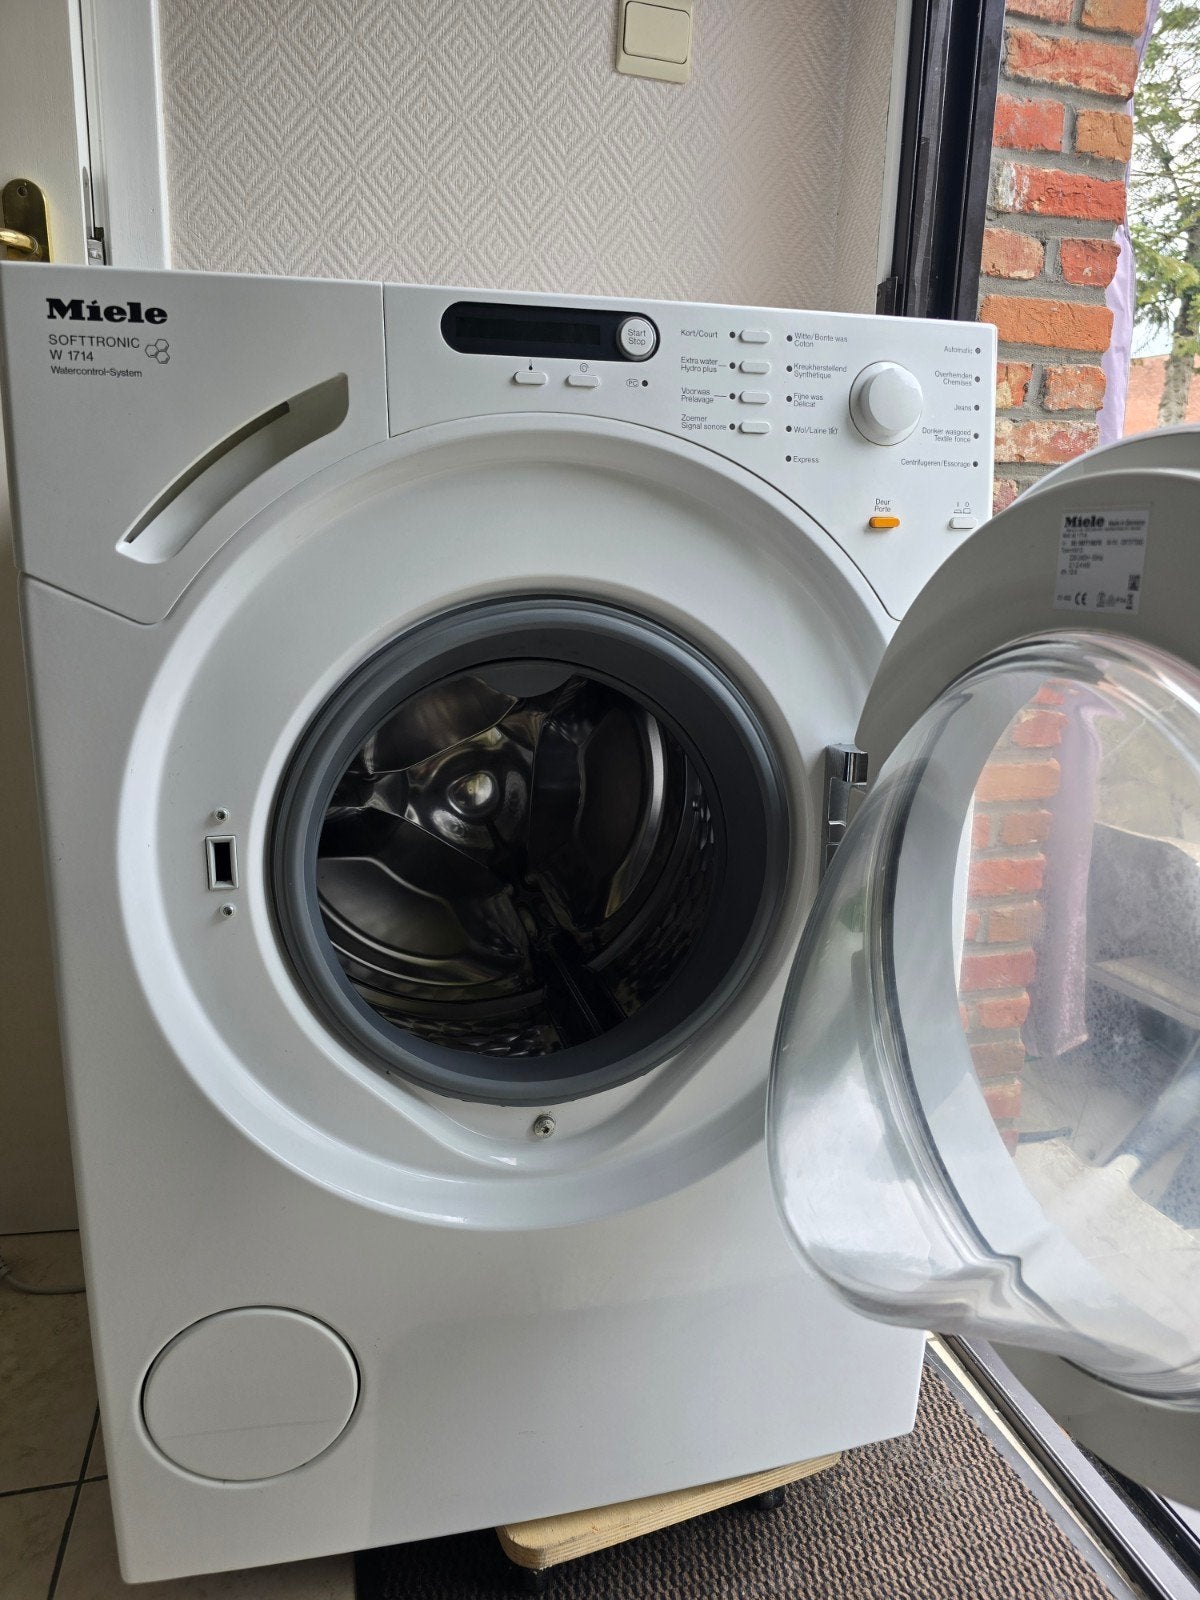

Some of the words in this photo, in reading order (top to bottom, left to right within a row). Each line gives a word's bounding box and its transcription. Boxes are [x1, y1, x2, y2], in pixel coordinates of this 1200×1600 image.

[46, 297, 168, 325] Miele
[627, 328, 646, 337] Start
[681, 329, 718, 338] Kort/Court
[794, 332, 834, 343] Witte/Bonte
[835, 335, 848, 343] was
[48, 333, 140, 348] SOFTTRONIC
[628, 336, 646, 346] Stop
[794, 340, 814, 348] Coton
[943, 345, 973, 354] Automatic
[50, 349, 63, 361] W
[68, 350, 94, 362] 1714
[680, 356, 699, 365] Extra
[699, 357, 718, 366] water
[51, 365, 143, 378] Watercontrol-System
[680, 364, 704, 374] Hydro
[702, 365, 718, 374] plus
[793, 362, 847, 373] Kreukherstellend
[934, 370, 973, 380] Overhemden
[942, 378, 973, 387] Chemises
[681, 387, 711, 396] Voorwas
[793, 392, 810, 402] Fijne
[953, 403, 972, 411] Jeans
[681, 413, 708, 422] Zoemer
[681, 421, 703, 431] Signal
[704, 422, 727, 431] sonore
[922, 426, 944, 436] Donker
[945, 428, 972, 438] wasgoed
[934, 434, 952, 443] Textile
[793, 455, 820, 464] Express
[875, 498, 891, 506] Deur
[874, 505, 891, 513] Porte
[1064, 515, 1105, 529] Miele
